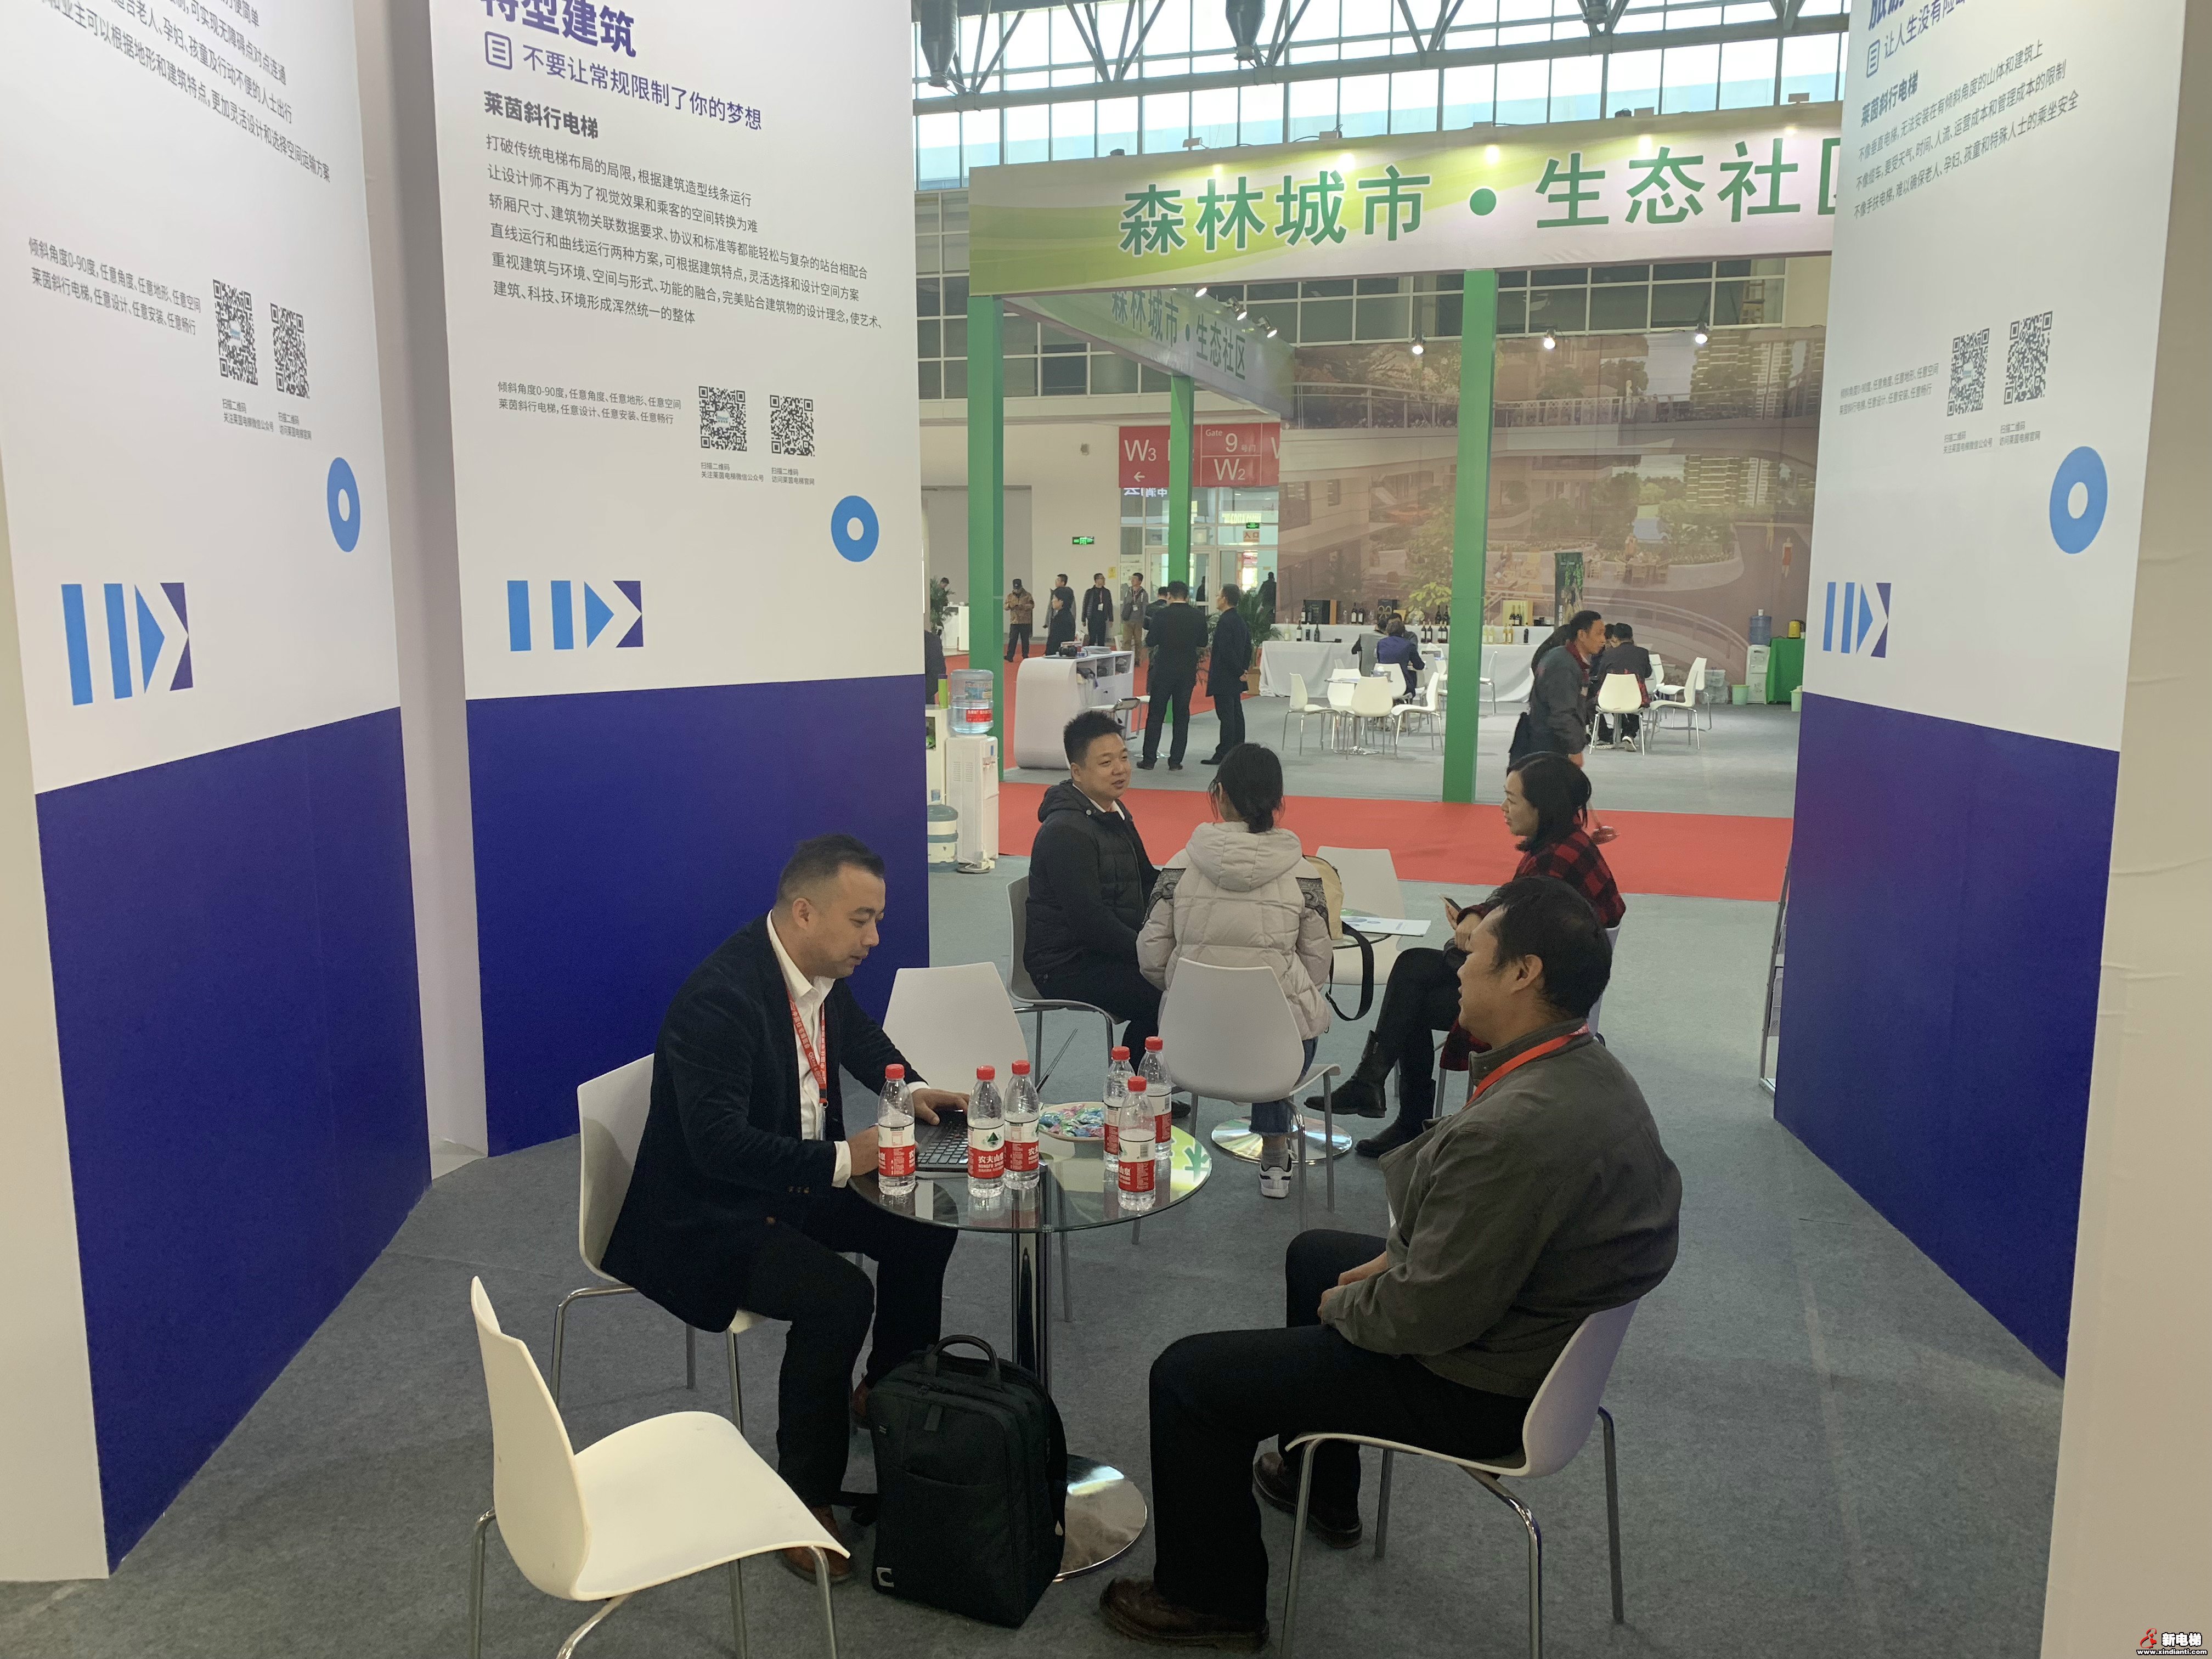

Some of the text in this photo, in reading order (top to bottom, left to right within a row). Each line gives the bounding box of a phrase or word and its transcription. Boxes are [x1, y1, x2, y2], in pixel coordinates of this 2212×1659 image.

[523, 44, 762, 130] 不要让常规限制了你的梦想
[1860, 70, 1918, 128] 莱茵斜行电梯
[484, 91, 599, 139] 莱茵斜行电梯
[486, 134, 751, 207] 打破传统电梯布局的局限,根据建筑造型线条运行
[488, 164, 758, 233] 让设计师不再为了视觉效果和乘客的空间转换为难
[494, 281, 695, 324] 建筑、科技、环境形成浑然统一的整体
[1124, 439, 1157, 461] W3
[1226, 432, 1238, 453] 9
[1214, 458, 1246, 481] W2
